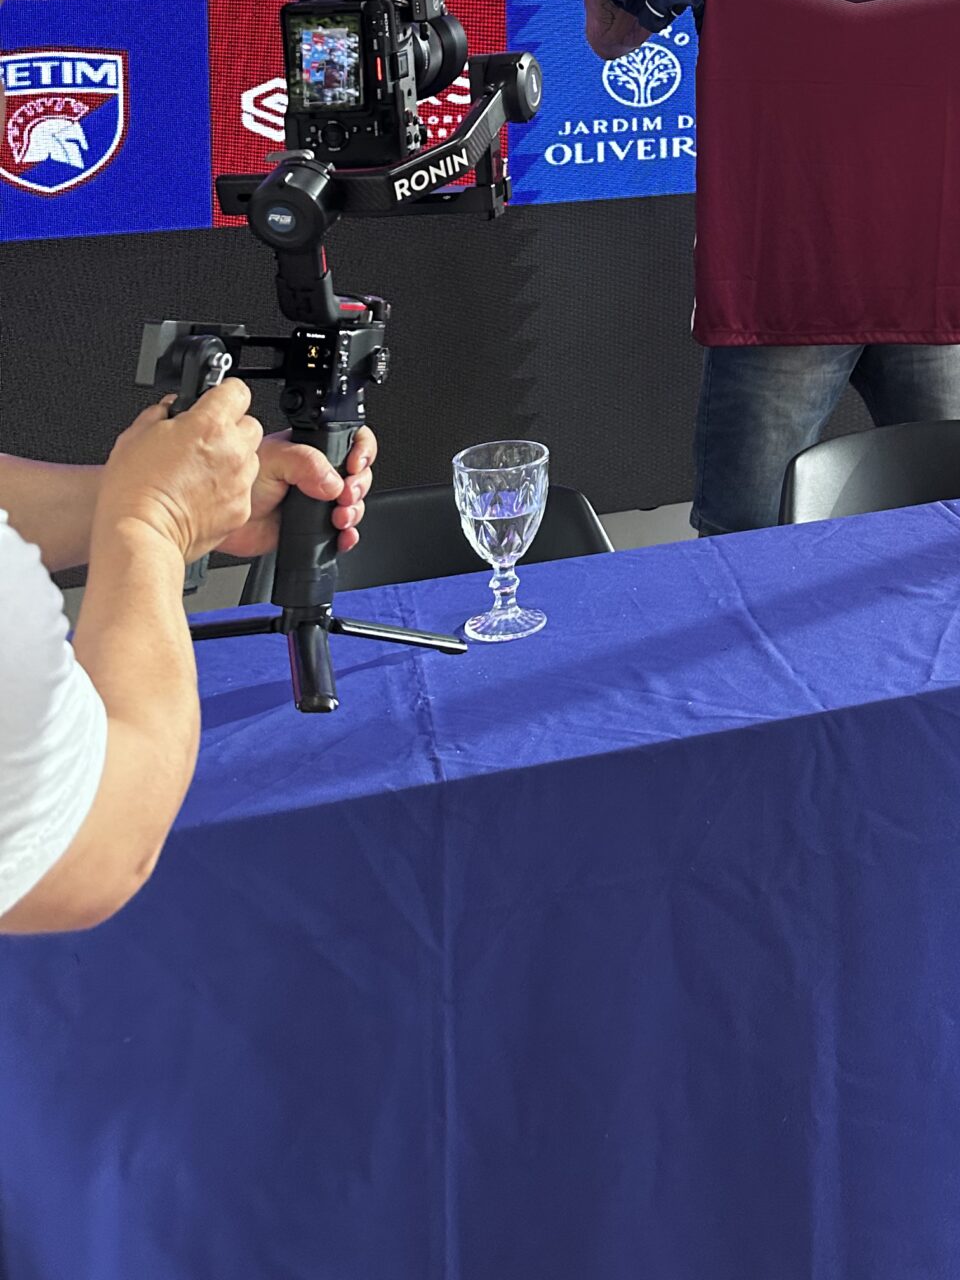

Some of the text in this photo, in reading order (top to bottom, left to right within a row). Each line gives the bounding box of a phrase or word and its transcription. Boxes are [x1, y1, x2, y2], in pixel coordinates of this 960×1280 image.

[0, 61, 117, 87] ETIM
[558, 117, 663, 135] JARDIM
[544, 136, 698, 166] OLIVEIR
[393, 148, 469, 201] RONIN
